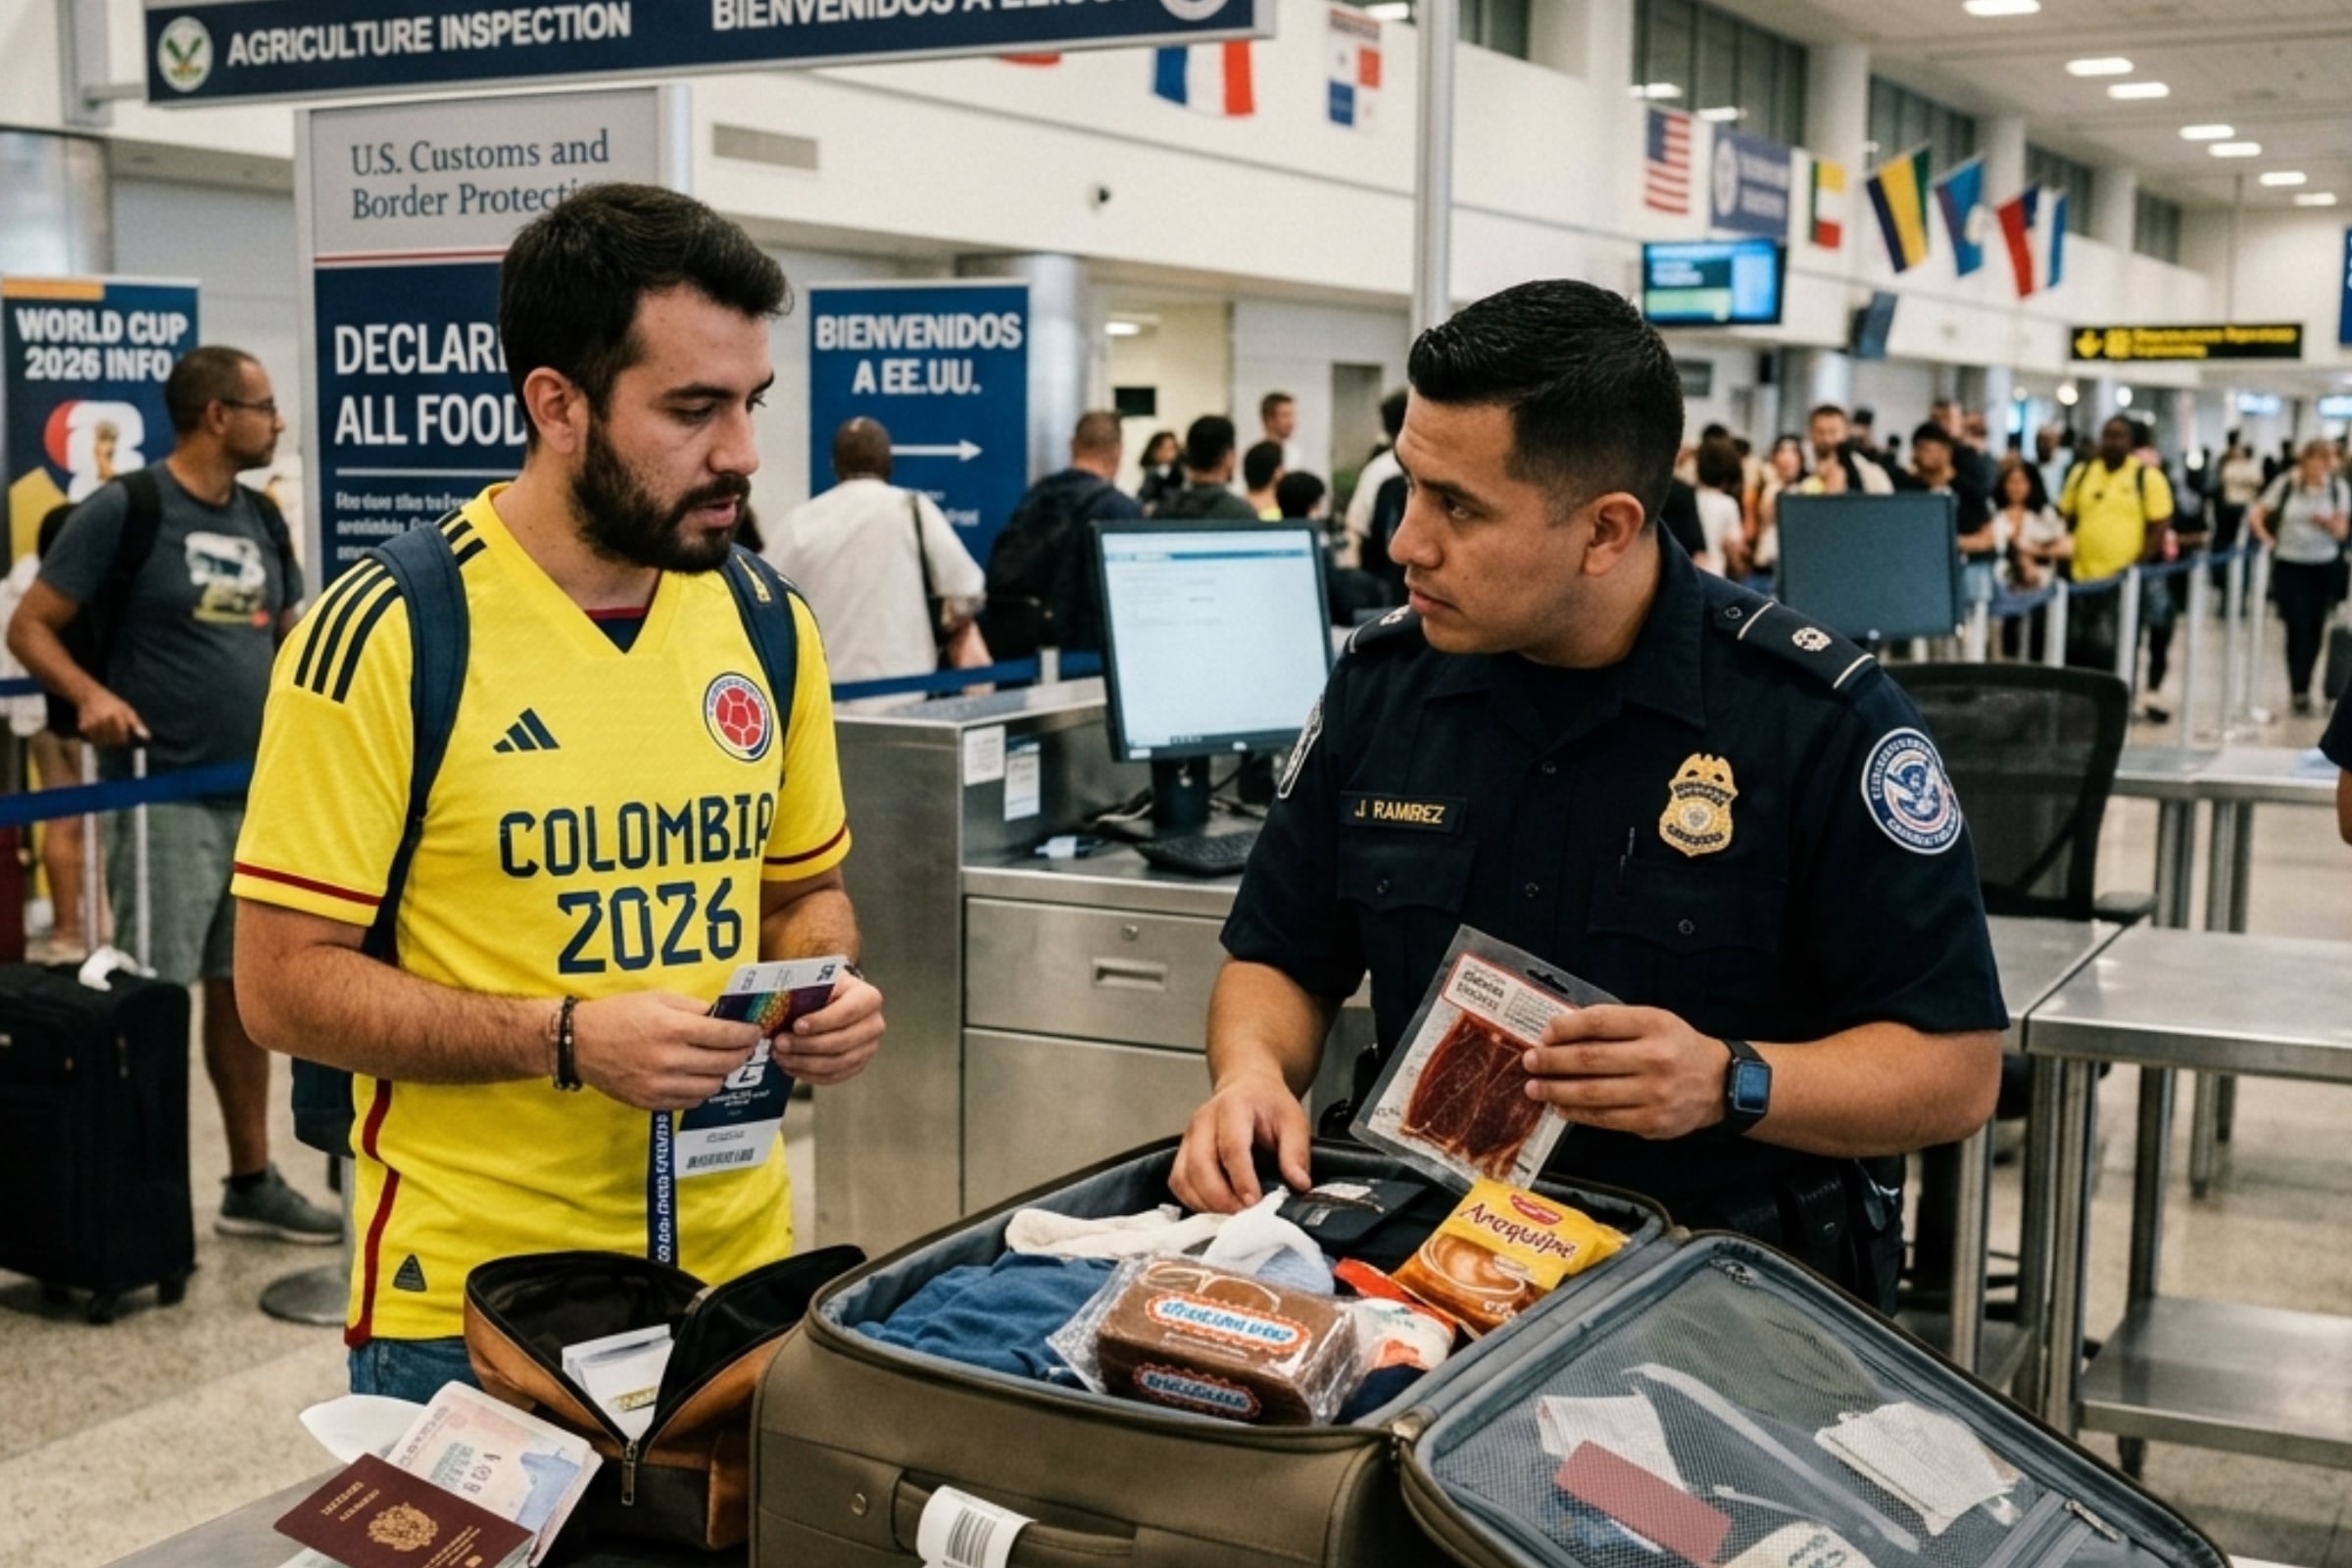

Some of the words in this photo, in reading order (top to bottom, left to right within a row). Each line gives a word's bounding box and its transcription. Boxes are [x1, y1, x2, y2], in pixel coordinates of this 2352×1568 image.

[226, 16, 432, 67] AGRICULTURE
[440, 1, 631, 50] INSPECTION
[351, 143, 402, 175] U.S.
[410, 140, 541, 172] Customs
[550, 127, 609, 166] and
[352, 183, 448, 220] Border
[458, 177, 577, 215] Protect
[15, 308, 123, 343] WORLD
[127, 311, 188, 346] CUP
[815, 312, 1022, 350] BIENVENIDOS
[24, 345, 102, 381] 2026
[105, 348, 173, 383] INFO
[851, 359, 877, 394] A
[881, 359, 982, 394] EE.UU.
[333, 394, 408, 446] ALL
[1354, 799, 1367, 817] J
[500, 792, 774, 878] COLOMBIA
[558, 877, 742, 974] 2026
